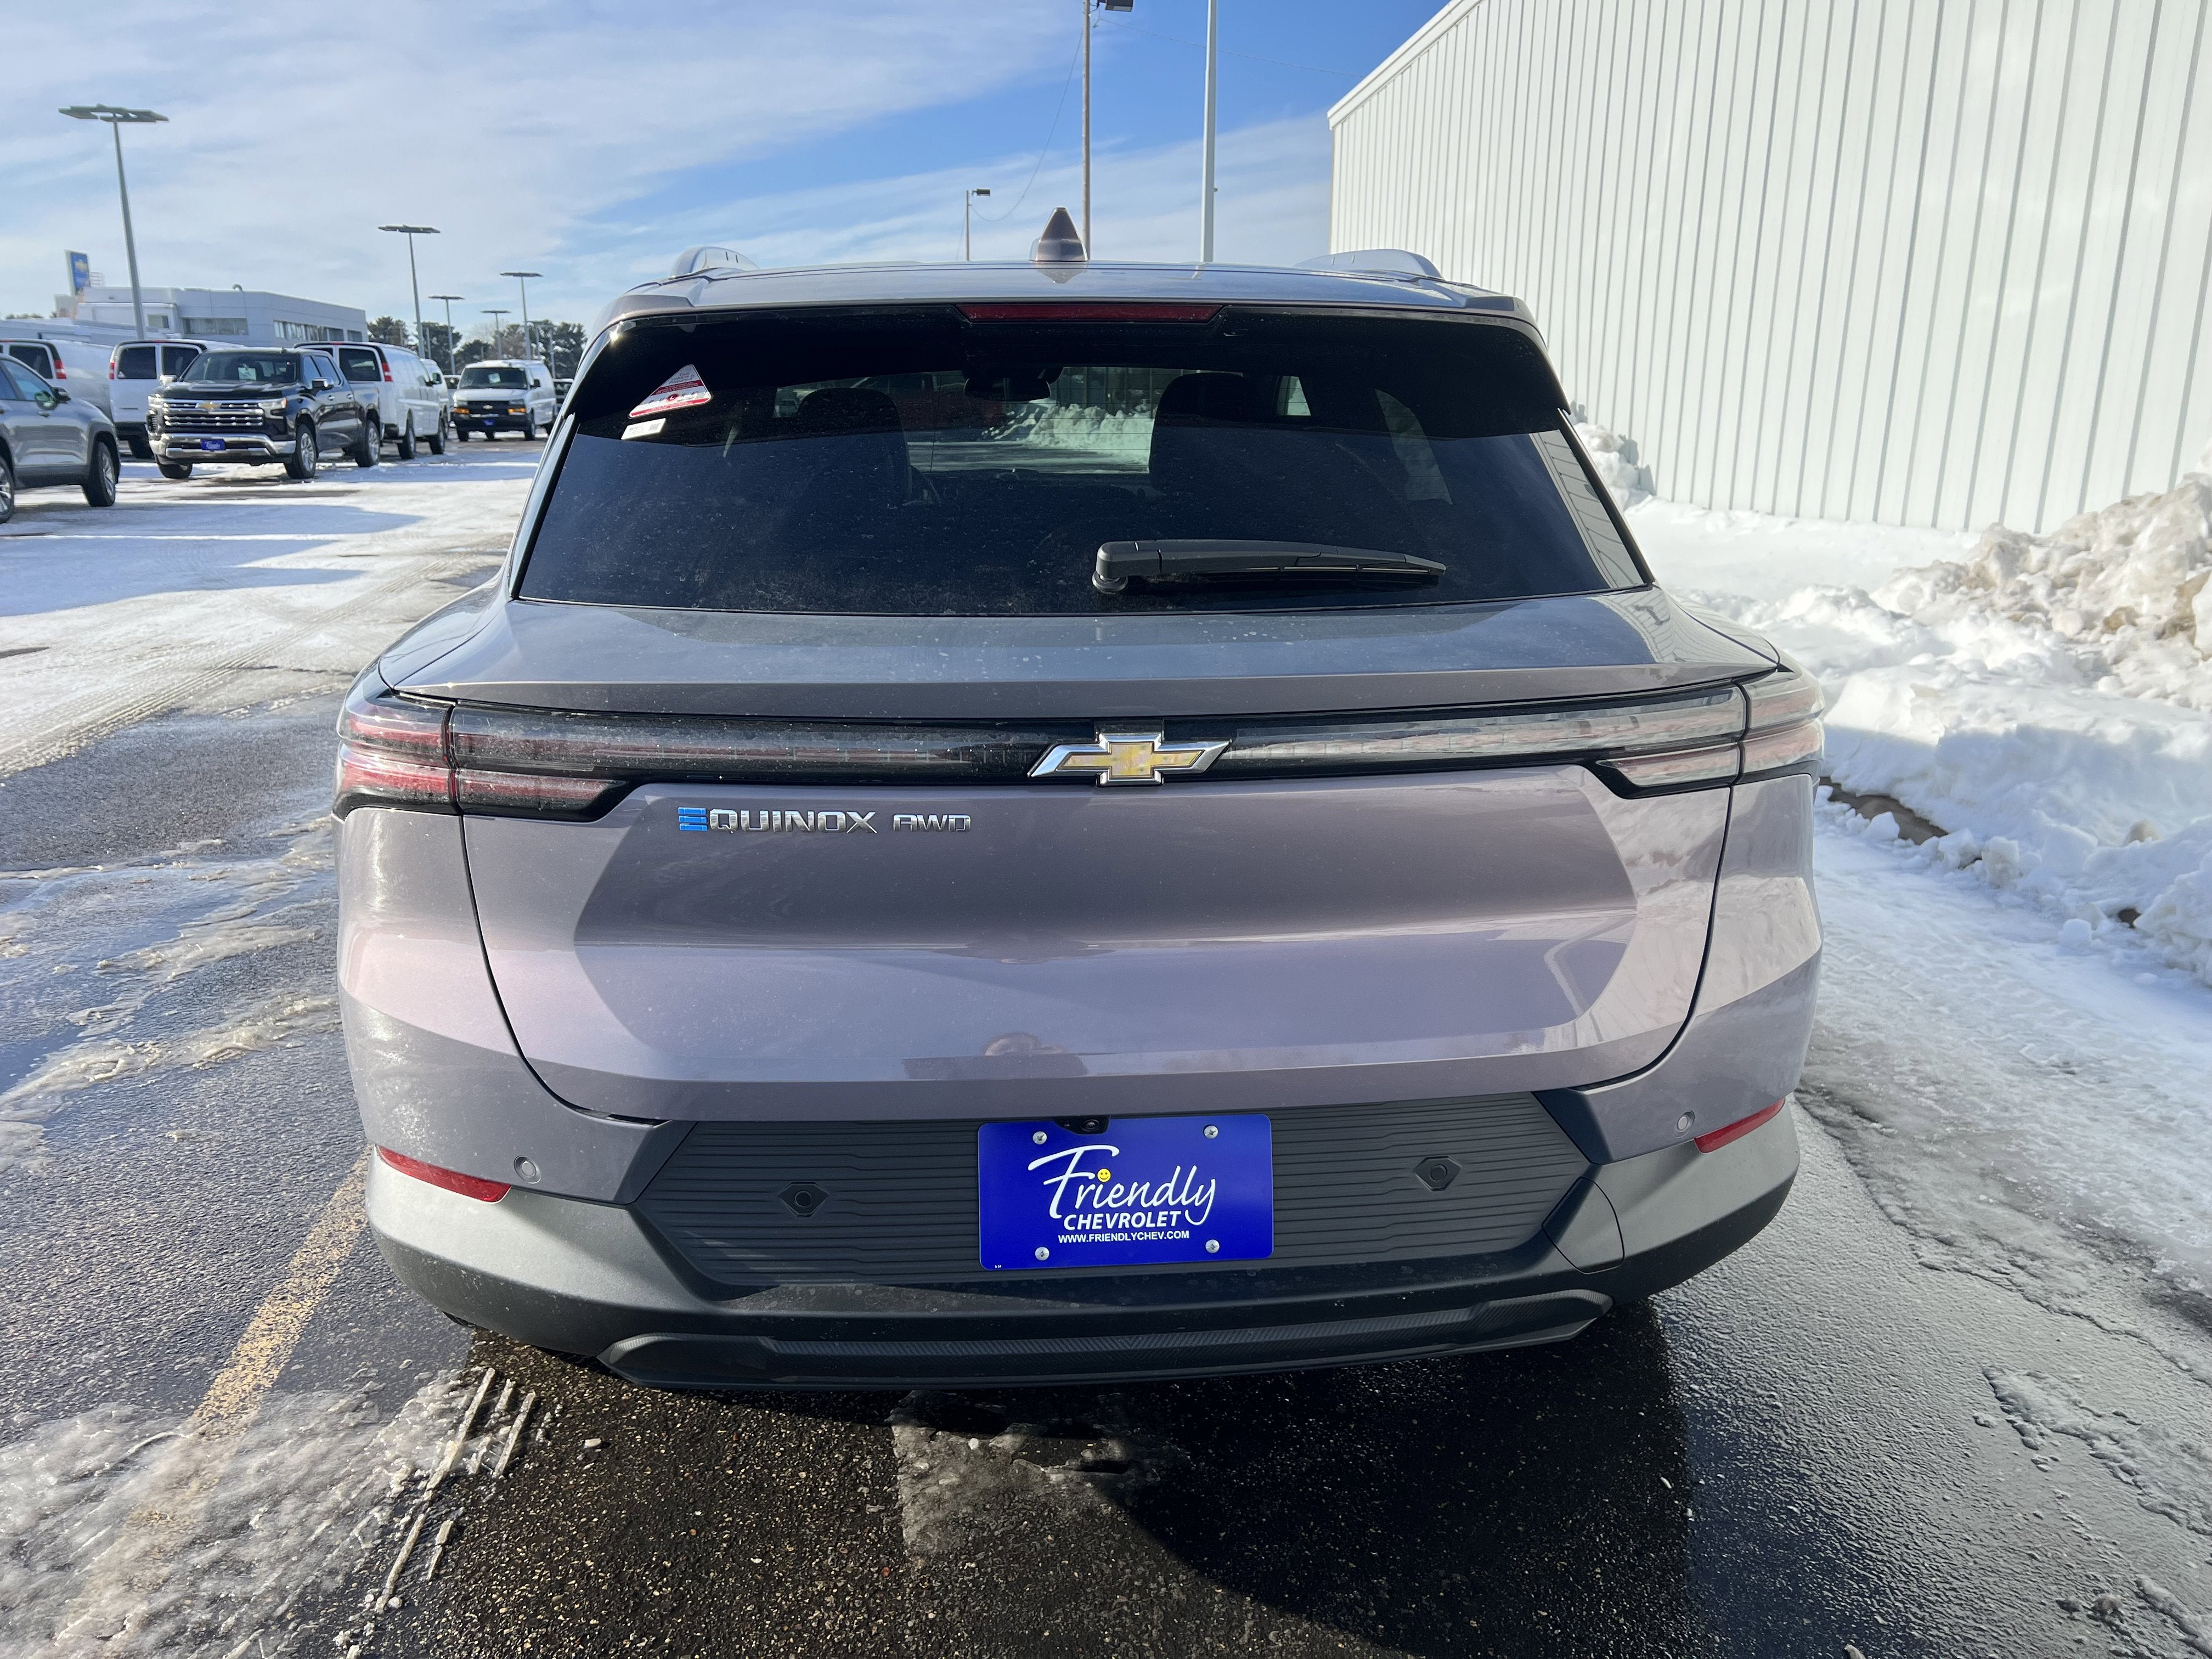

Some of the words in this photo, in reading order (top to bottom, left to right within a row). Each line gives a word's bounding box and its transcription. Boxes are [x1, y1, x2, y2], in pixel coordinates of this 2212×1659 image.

[678, 807, 878, 833] EQUINOX
[893, 814, 972, 832] AWD
[1028, 1145, 1216, 1226] Friendly
[1064, 1211, 1181, 1230] CHEVROLET
[1058, 1231, 1189, 1243] WWW.FRIENDLYCHEV.COM
